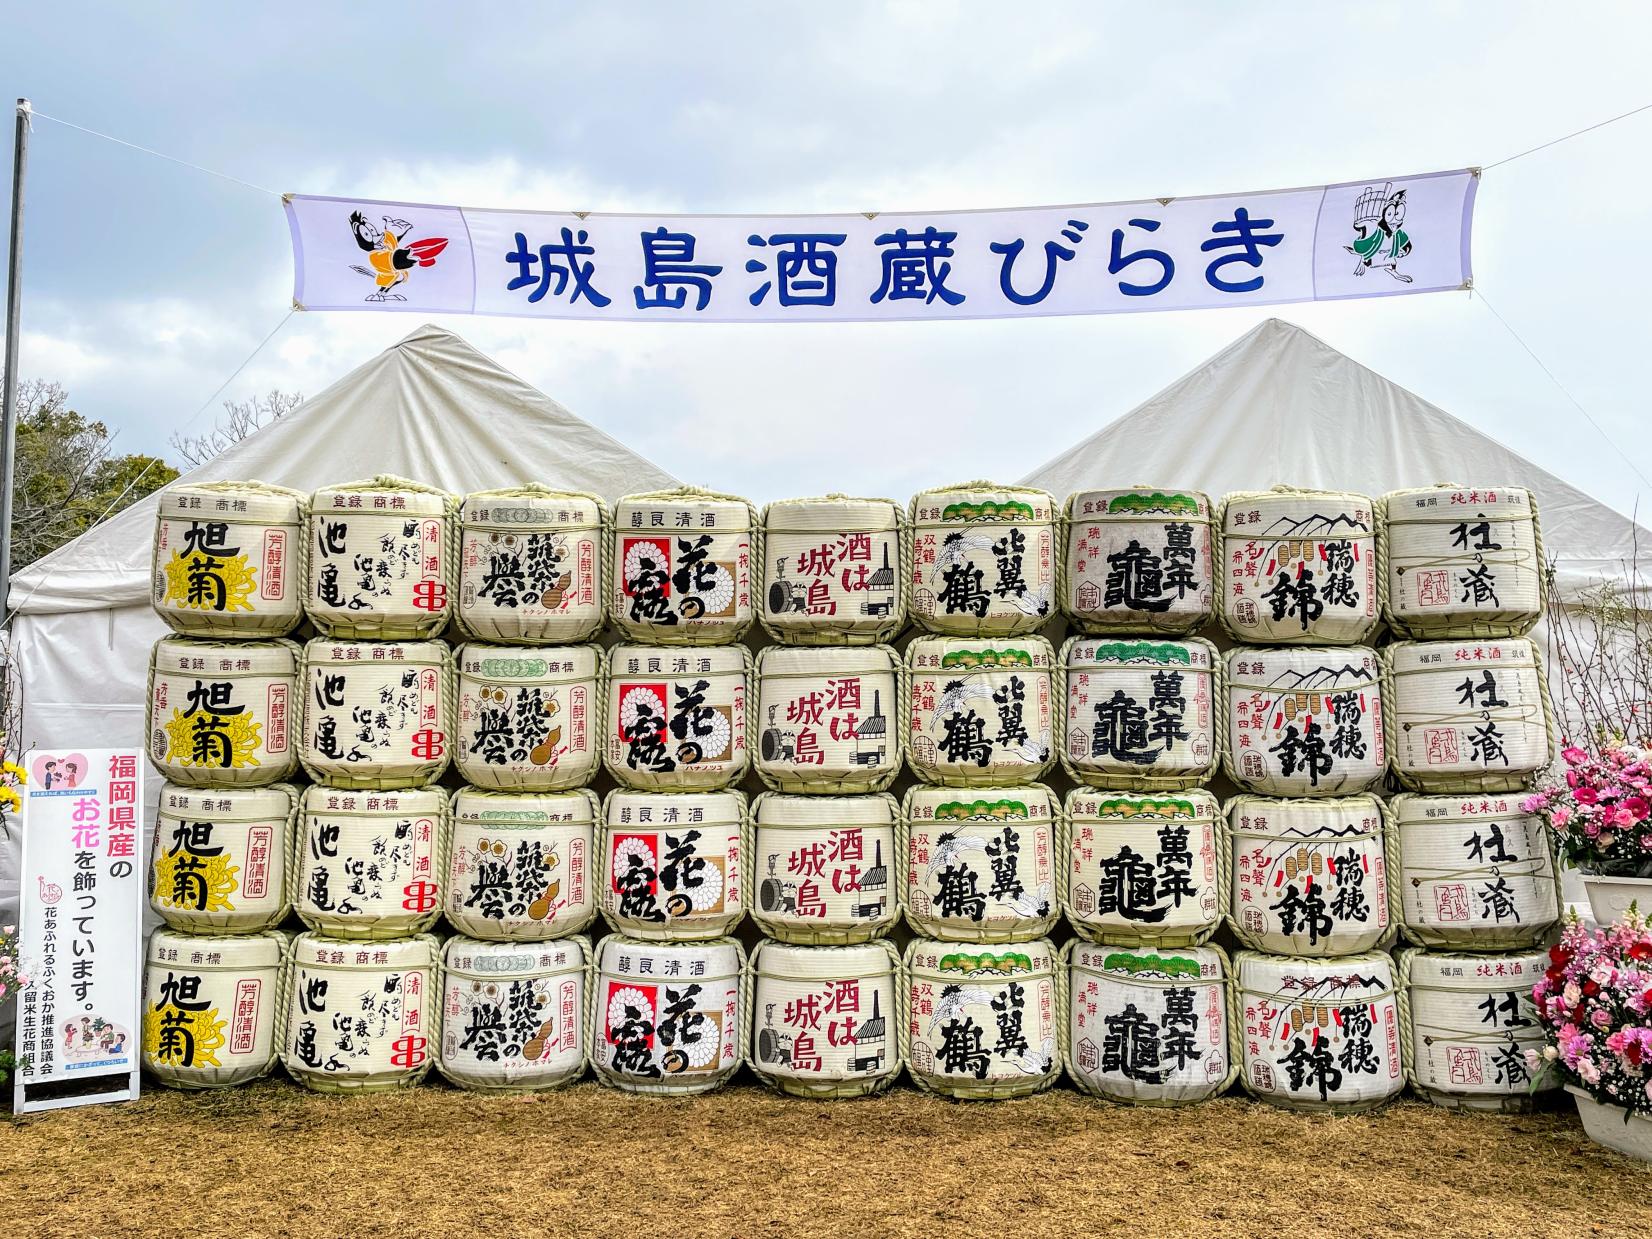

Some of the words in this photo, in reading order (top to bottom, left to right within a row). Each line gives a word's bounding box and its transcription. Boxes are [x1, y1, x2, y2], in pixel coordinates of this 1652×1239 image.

[506, 208, 1283, 310] 城島酒蔵びらき
[215, 499, 247, 512] 商標
[333, 495, 362, 508] 登録
[374, 495, 406, 510] 商標
[1416, 497, 1437, 507] 福岡
[1450, 491, 1497, 505] 純米酒
[180, 520, 240, 611] 旭菊
[425, 526, 438, 572] 清酒
[838, 533, 872, 592] 酒は
[797, 544, 837, 616] 城島
[937, 561, 991, 618] 鶴
[1261, 569, 1324, 630] 錦
[220, 659, 250, 672] 商標
[331, 647, 361, 660] 登録
[373, 647, 404, 662] 商標
[1420, 653, 1441, 663] 福岡
[1454, 647, 1502, 662] 純米酒
[183, 679, 245, 771] 旭菊
[423, 675, 436, 720] 清酒
[826, 678, 863, 742] 酒は
[786, 691, 826, 765] 城島
[937, 709, 994, 768] 鶴
[1268, 722, 1334, 786] 錦
[107, 755, 136, 878] 福岡県産の
[201, 798, 232, 812] 商標
[327, 796, 356, 810] 登録
[367, 796, 400, 812] 商標
[1426, 807, 1447, 817] 福岡
[1460, 800, 1509, 815] 純米酒
[165, 819, 224, 912] 旭菊
[416, 825, 431, 872] 清酒
[828, 831, 865, 894] 酒は
[71, 798, 101, 1010] お花を飾っています。
[787, 843, 828, 918] 城島
[931, 862, 988, 922] 鶴
[1269, 881, 1335, 946] 錦
[190, 951, 220, 966] 商標
[315, 951, 345, 965] 登録
[356, 950, 390, 967] 商標
[1441, 965, 1463, 977] 福岡
[1476, 962, 1524, 979] 純米酒
[40, 906, 57, 1074] 花あふれるふくおか推進協議会
[152, 972, 211, 1067] 旭菊
[404, 978, 421, 1027] 清酒
[824, 982, 861, 1047] 酒は
[784, 995, 823, 1071] 城島
[935, 1015, 992, 1079] 鶴
[1276, 1036, 1345, 1100] 錦
